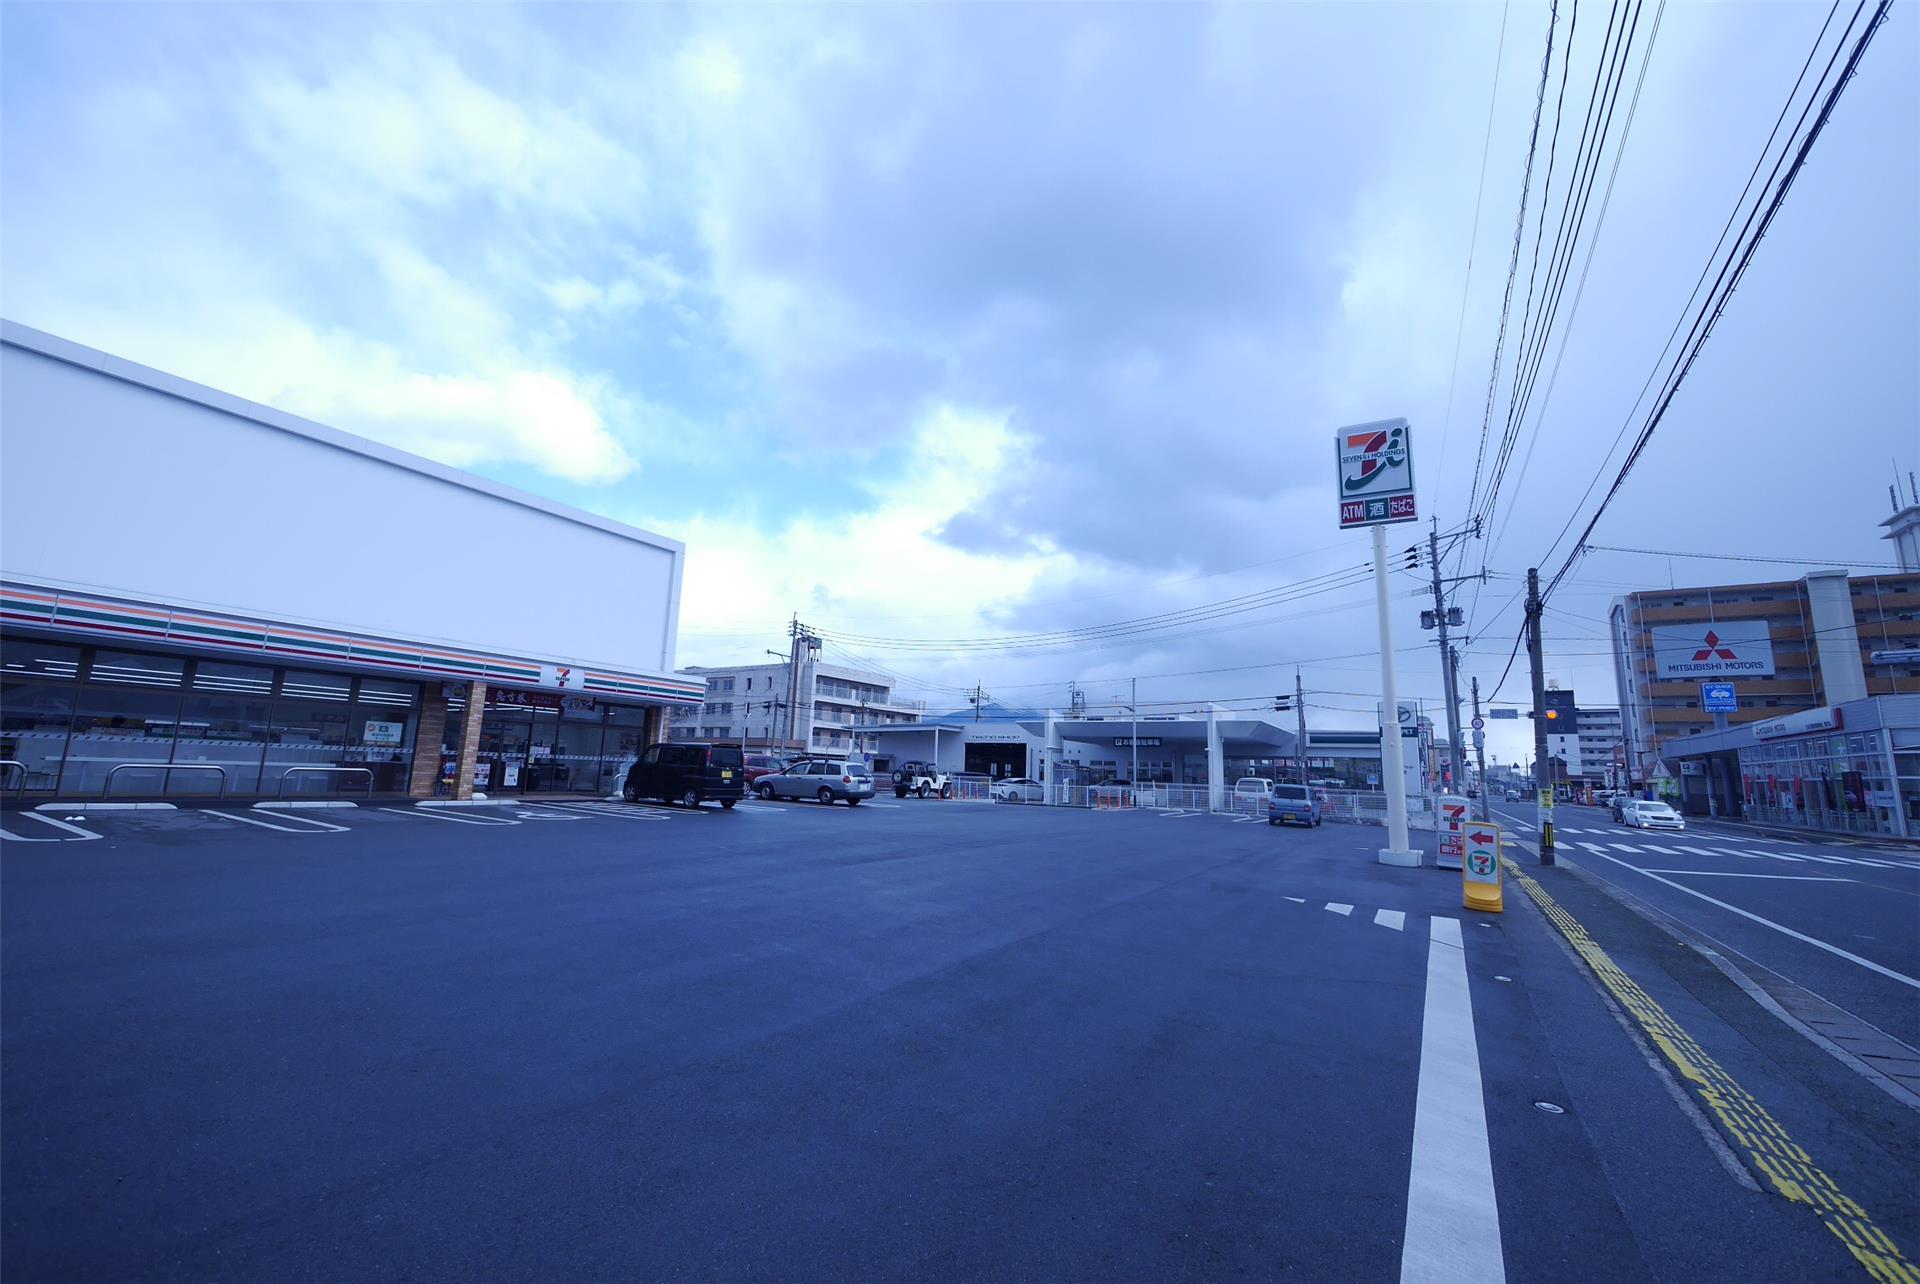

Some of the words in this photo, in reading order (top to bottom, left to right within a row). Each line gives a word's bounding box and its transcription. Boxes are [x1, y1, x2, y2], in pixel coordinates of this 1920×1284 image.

[1371, 447, 1405, 460] HOLDINGS
[1342, 504, 1364, 520] ATM
[1369, 502, 1385, 517] 酒
[1390, 498, 1415, 514] たばこ
[1668, 662, 1722, 673] MITSUBISHI
[1724, 660, 1764, 671] MOTORS
